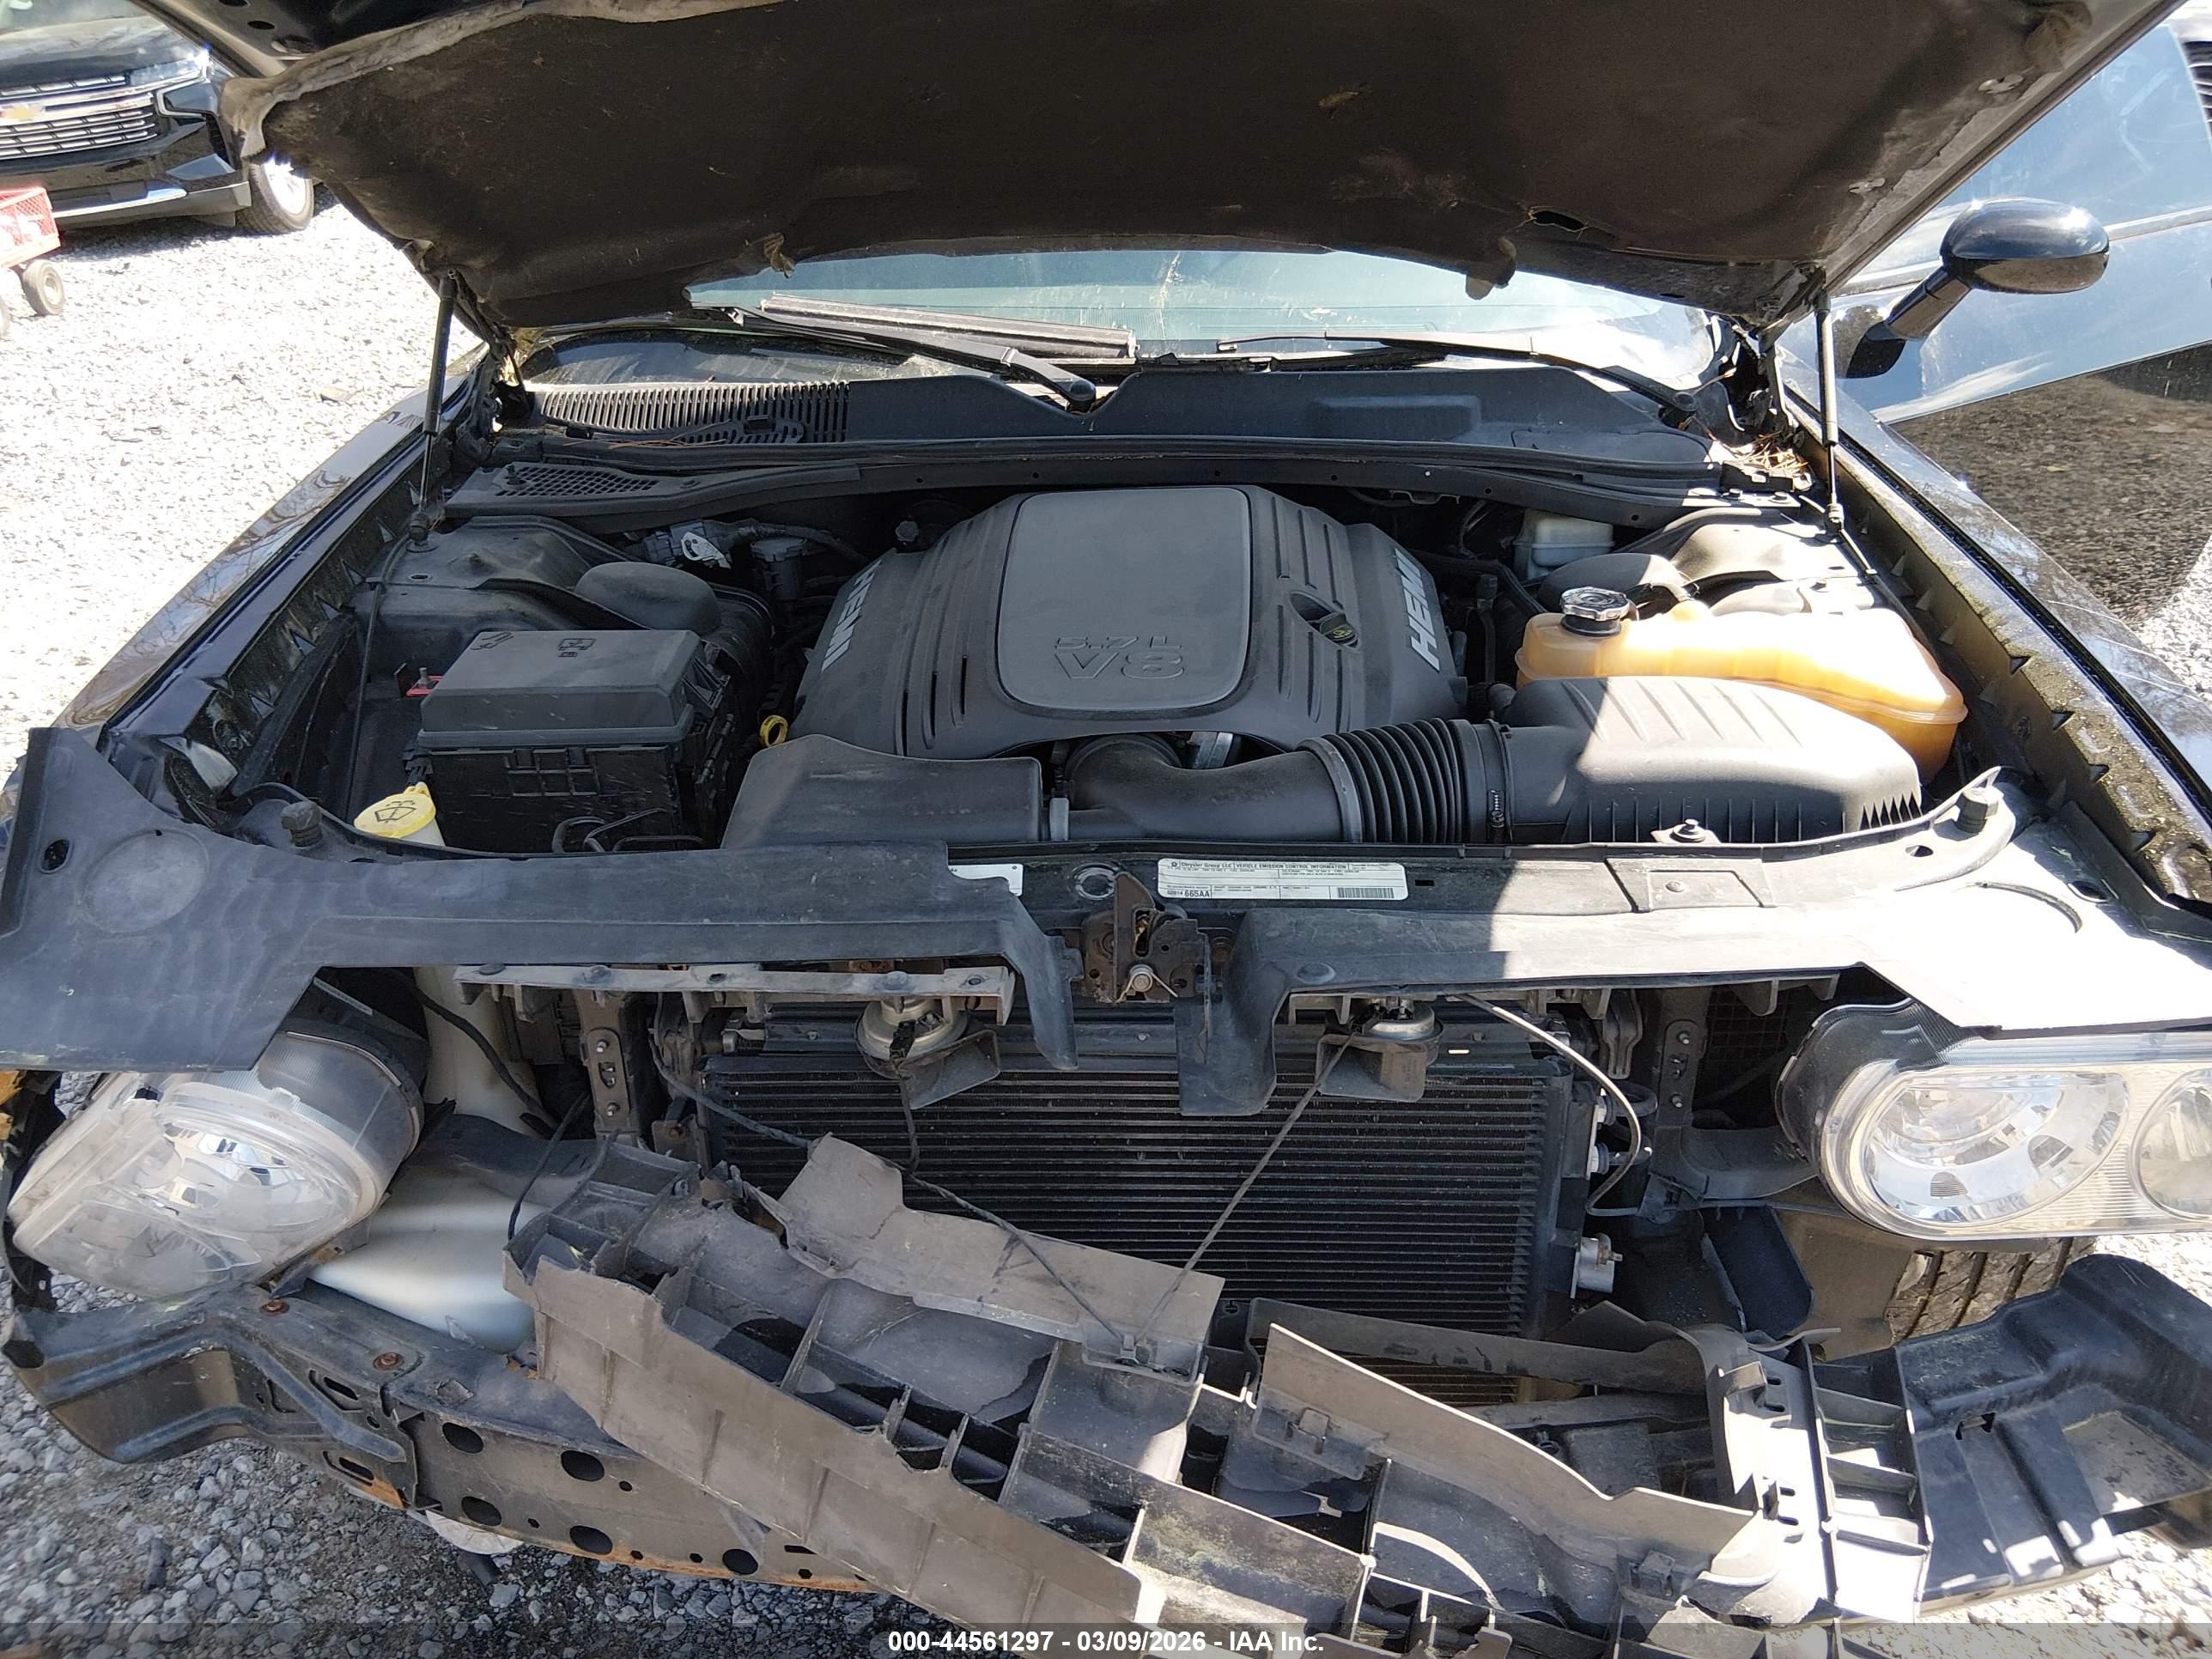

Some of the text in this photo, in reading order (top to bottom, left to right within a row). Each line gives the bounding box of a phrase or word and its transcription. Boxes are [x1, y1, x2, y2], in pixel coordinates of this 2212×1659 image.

[821, 559, 883, 672] HEMI
[1054, 651, 1185, 680] V8
[1395, 548, 1440, 672] HEMI
